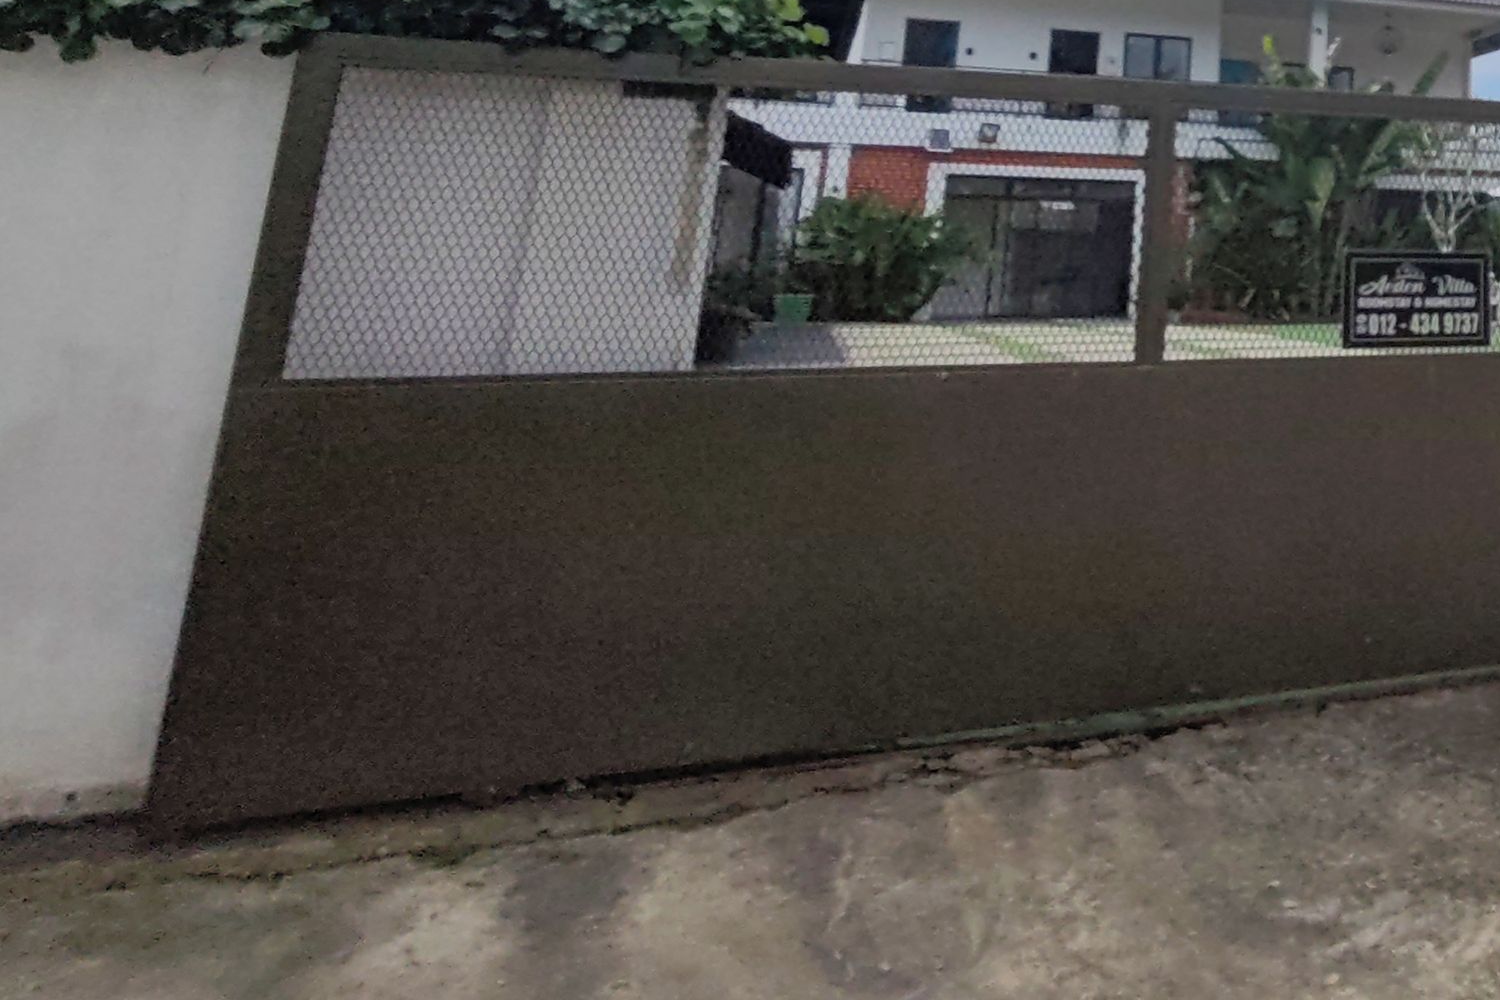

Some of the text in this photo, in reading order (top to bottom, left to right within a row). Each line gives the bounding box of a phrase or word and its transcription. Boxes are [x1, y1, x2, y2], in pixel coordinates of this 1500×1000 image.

[1368, 312, 1397, 336] 012
[1409, 312, 1440, 335] 434
[1443, 311, 1479, 335] 9737
